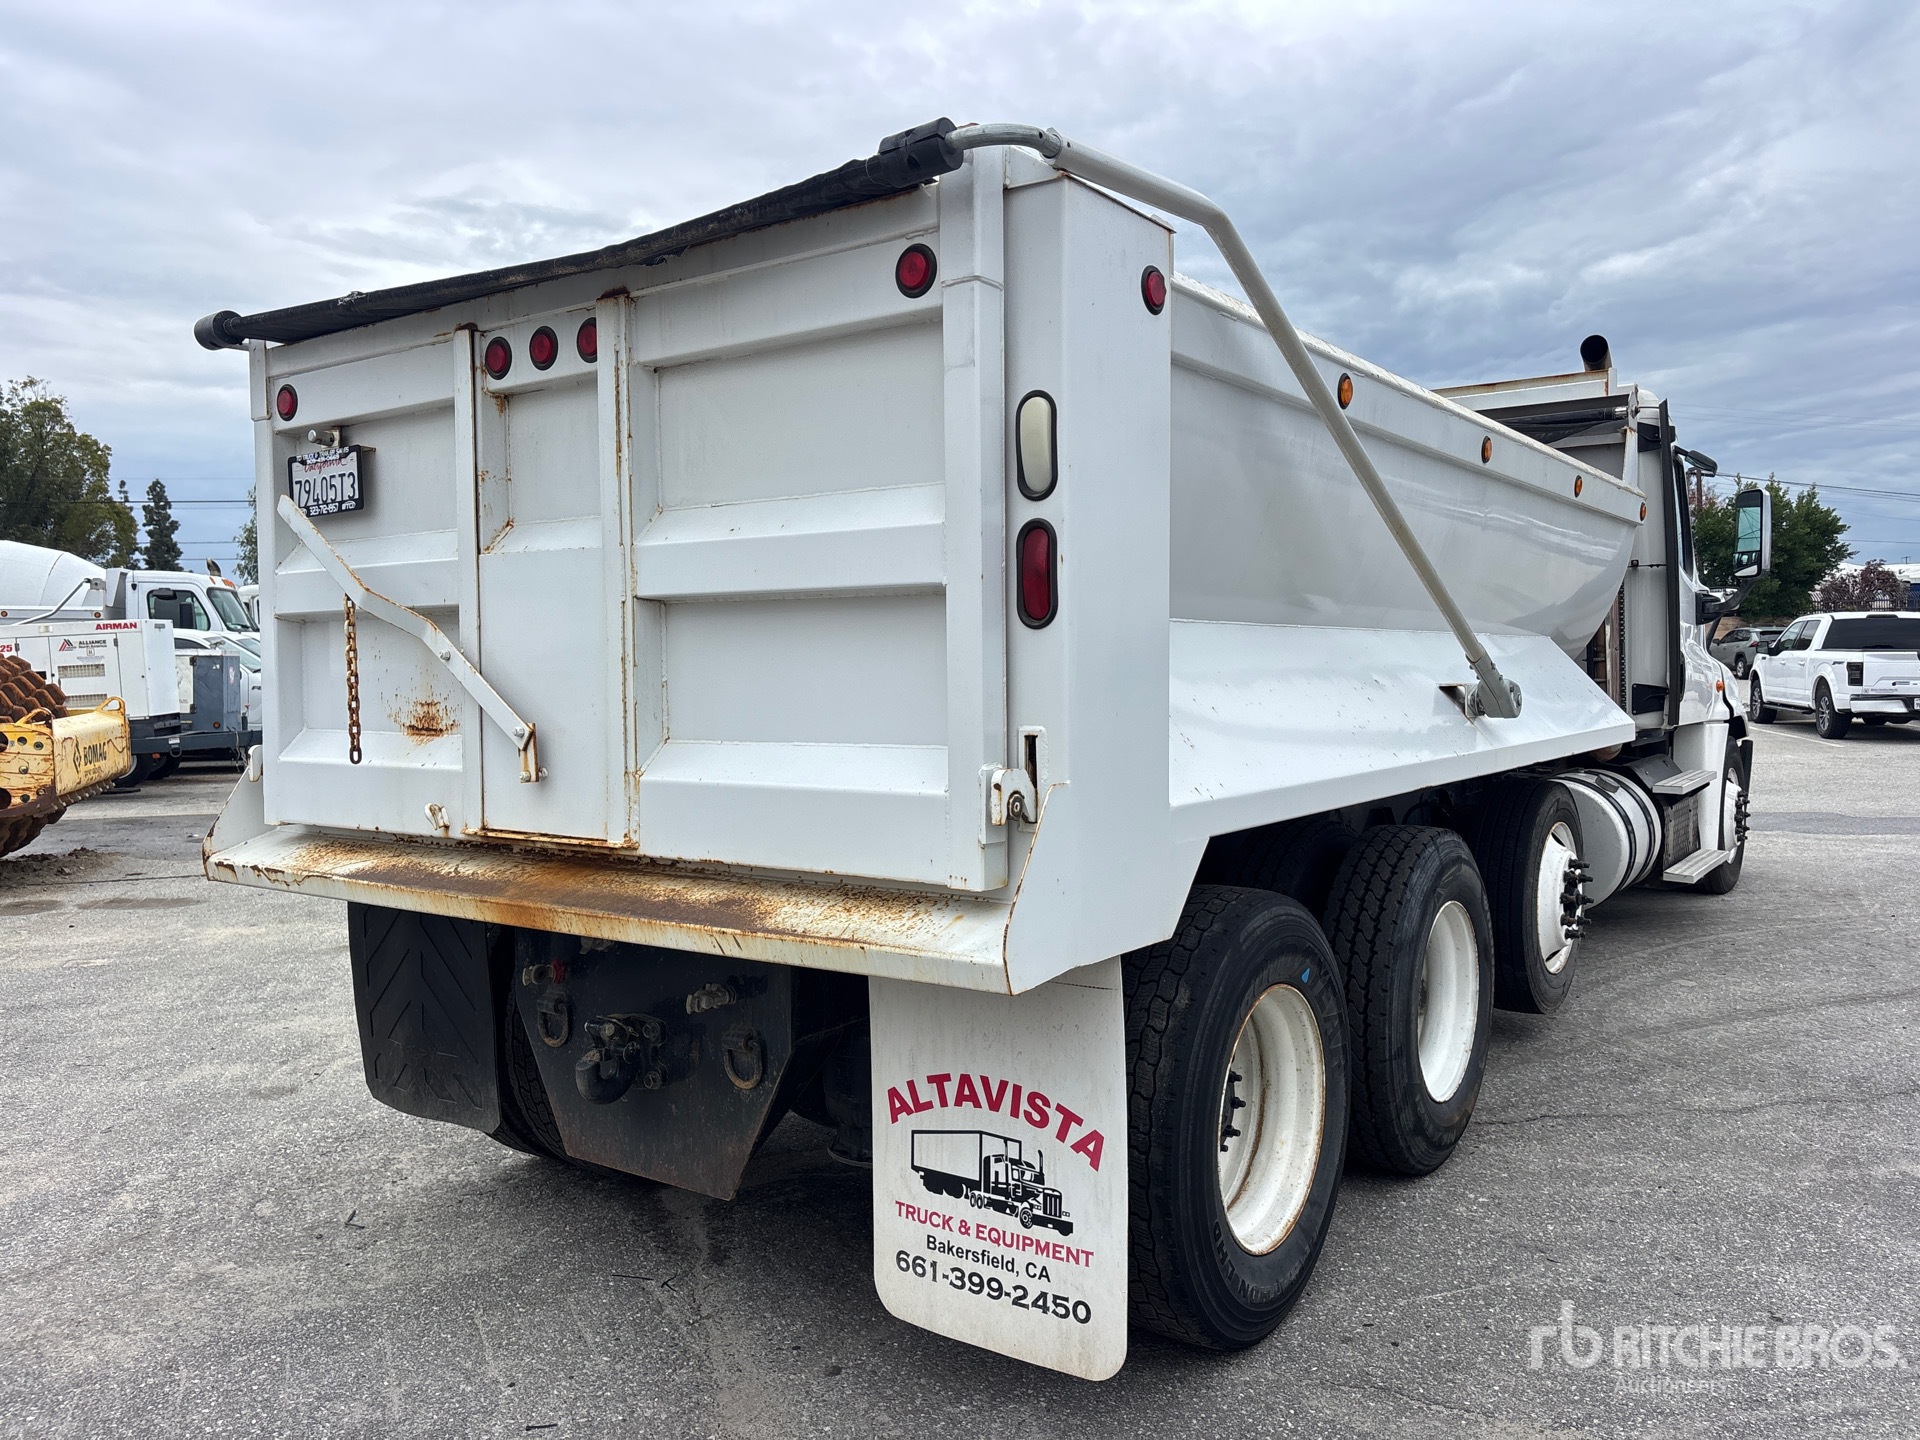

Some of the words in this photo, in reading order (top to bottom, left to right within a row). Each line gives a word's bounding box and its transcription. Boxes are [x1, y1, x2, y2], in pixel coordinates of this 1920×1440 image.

[295, 472, 356, 508] 79405T3
[95, 622, 138, 631] AIRMAN
[83, 741, 107, 767] BOMAG
[887, 1072, 1105, 1172] ALTAVISTA
[895, 1199, 954, 1233] TRUCK
[957, 1218, 971, 1237] &
[975, 1222, 1095, 1268] EQUIPMENT
[926, 1234, 1020, 1278] Bakersfield,
[1025, 1261, 1052, 1283] CA
[895, 1249, 1092, 1325] 661-399-2450
